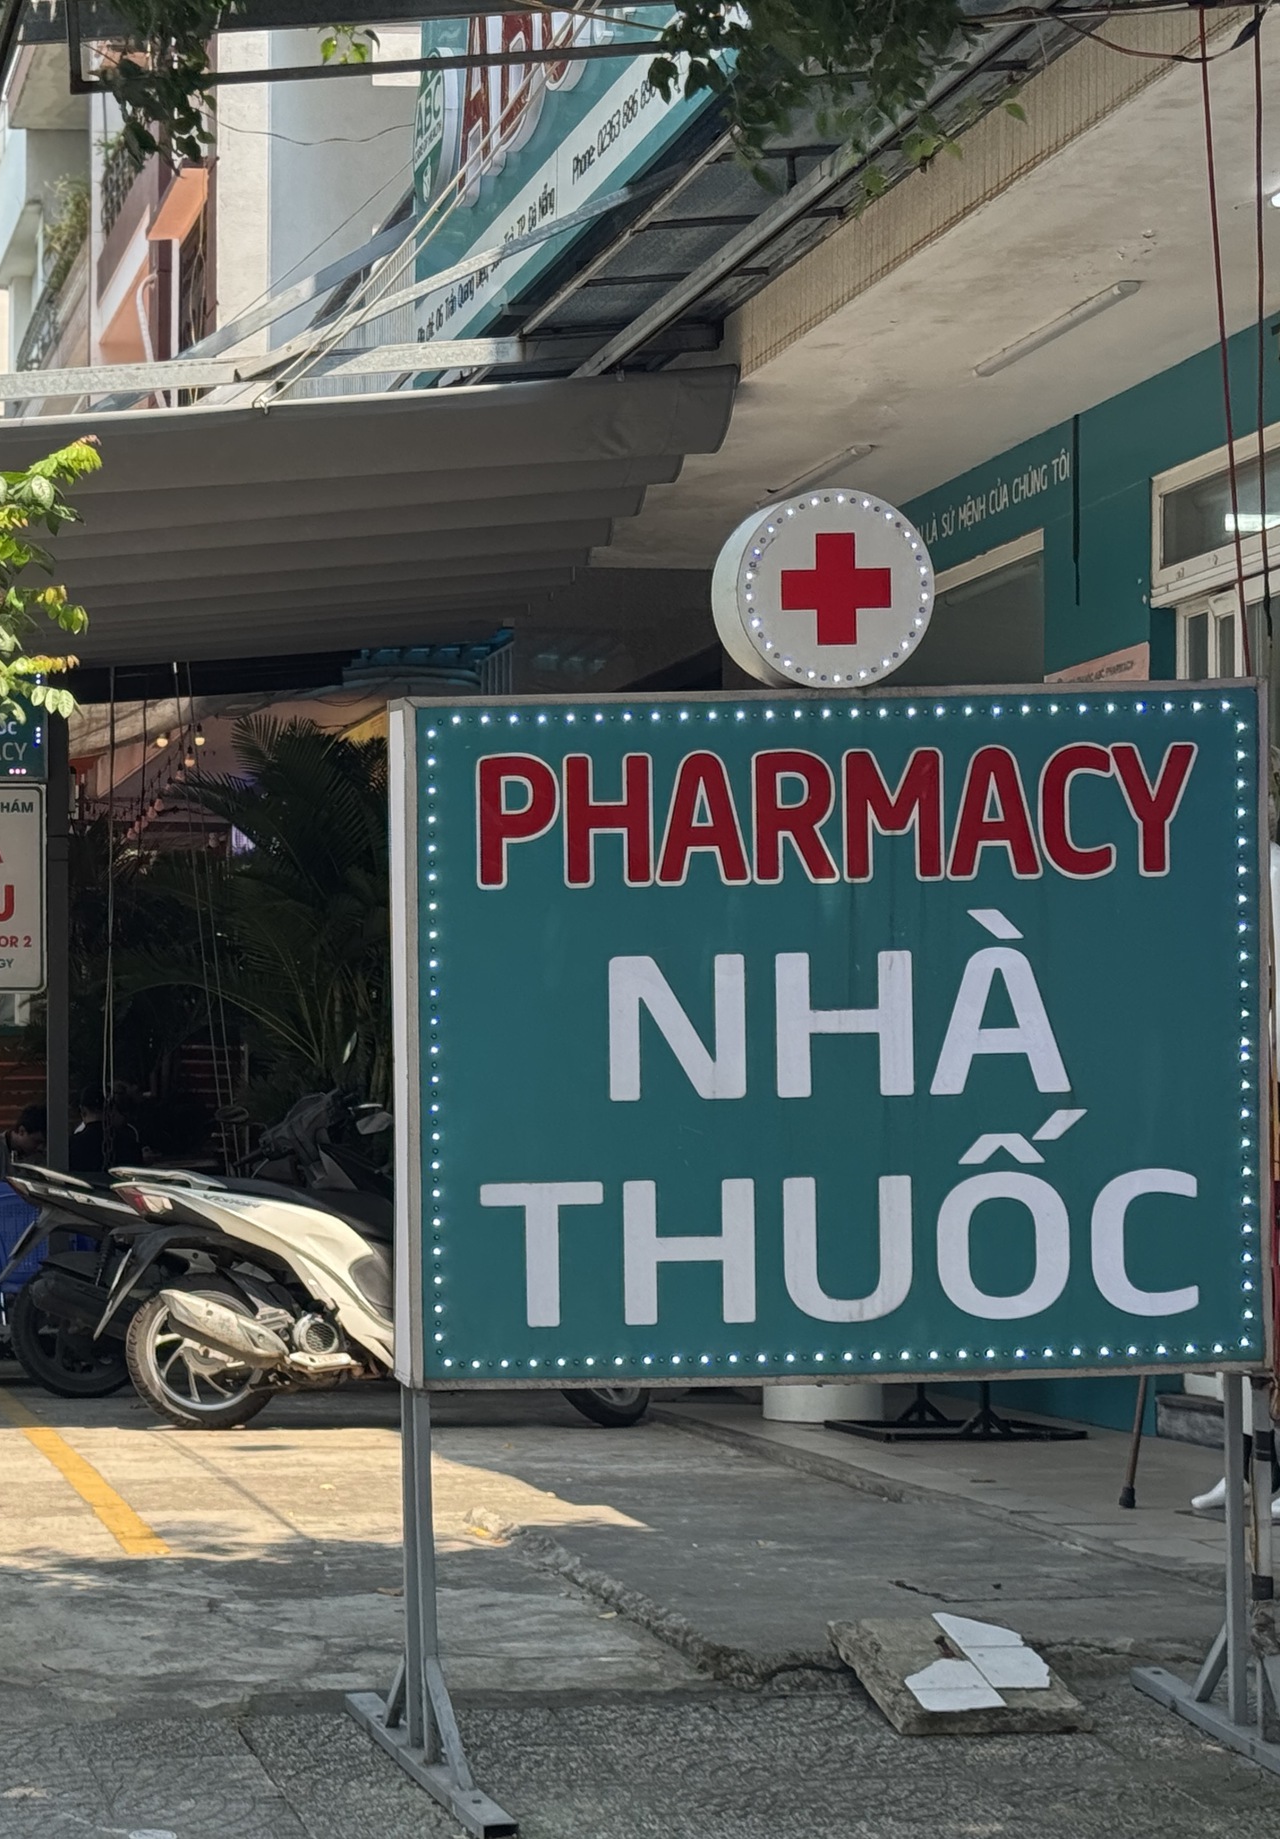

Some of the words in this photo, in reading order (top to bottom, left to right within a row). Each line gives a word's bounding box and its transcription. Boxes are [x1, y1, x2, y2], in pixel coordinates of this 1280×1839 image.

[926, 512, 938, 545] LÀ
[941, 505, 955, 538] SỨ
[958, 495, 986, 531] MỆNH
[989, 477, 1009, 515] CỦA
[1012, 465, 1048, 504] CHÚNG
[1052, 448, 1070, 485] TÔI
[475, 742, 1199, 890] PHARMACY
[23, 935, 32, 948] 2
[608, 908, 1071, 1102] NHÀ
[479, 1109, 1200, 1328] THUỐC
